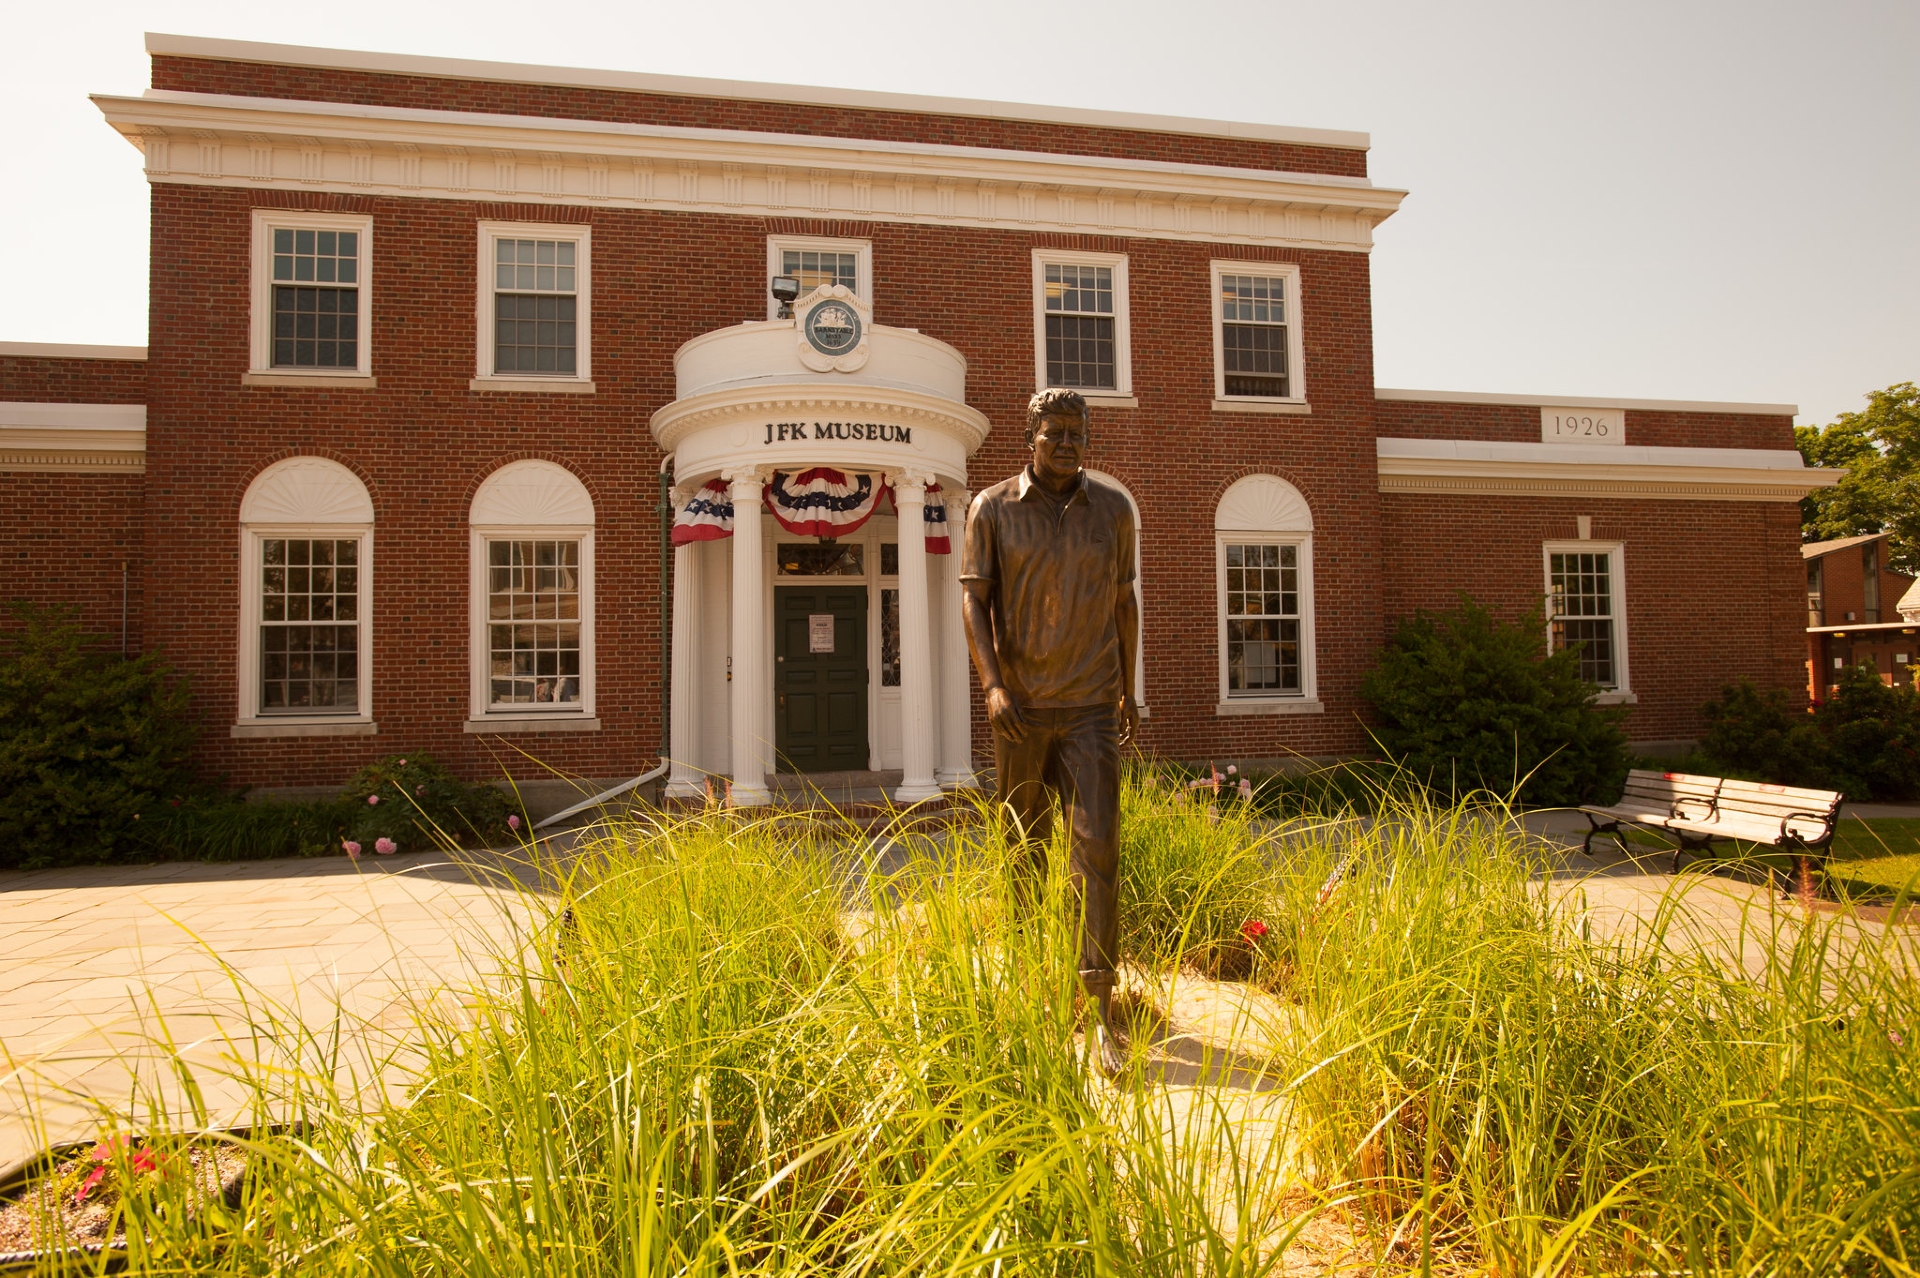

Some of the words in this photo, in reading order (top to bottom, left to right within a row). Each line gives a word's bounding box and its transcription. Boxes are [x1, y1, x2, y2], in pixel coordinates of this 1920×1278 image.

[764, 422, 808, 445] JFK
[814, 422, 911, 444] MUSEUM
[1555, 416, 1608, 436] 1926
